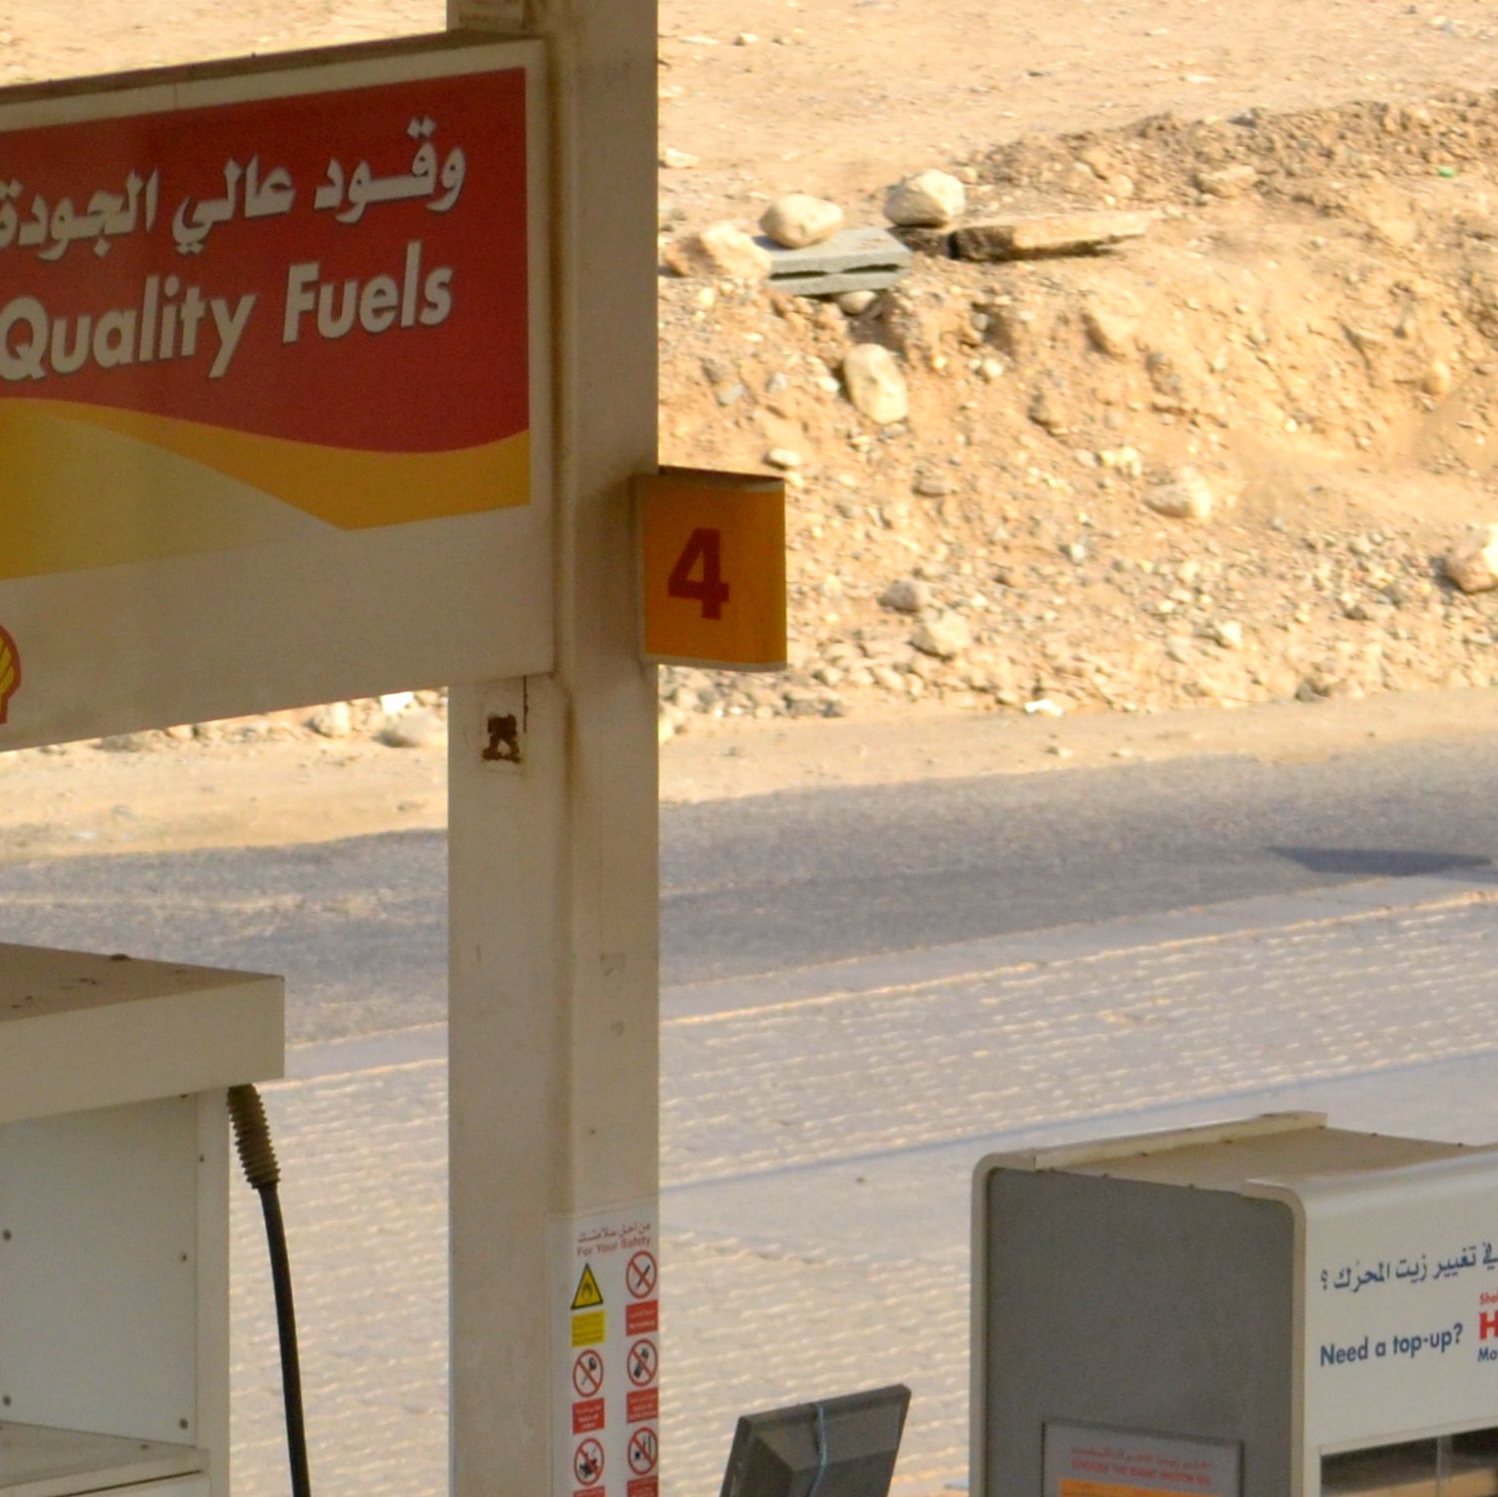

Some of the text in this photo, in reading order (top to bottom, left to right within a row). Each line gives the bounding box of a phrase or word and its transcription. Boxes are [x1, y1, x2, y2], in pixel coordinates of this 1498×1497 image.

[172, 155, 296, 255] عالي
[315, 117, 466, 223] وقود
[282, 241, 454, 344] Fuels
[667, 526, 730, 621] 4
[1395, 1254, 1428, 1282] زيت
[1433, 1246, 1478, 1279] تغيير
[1320, 1322, 1464, 1366] Need a top-up?
